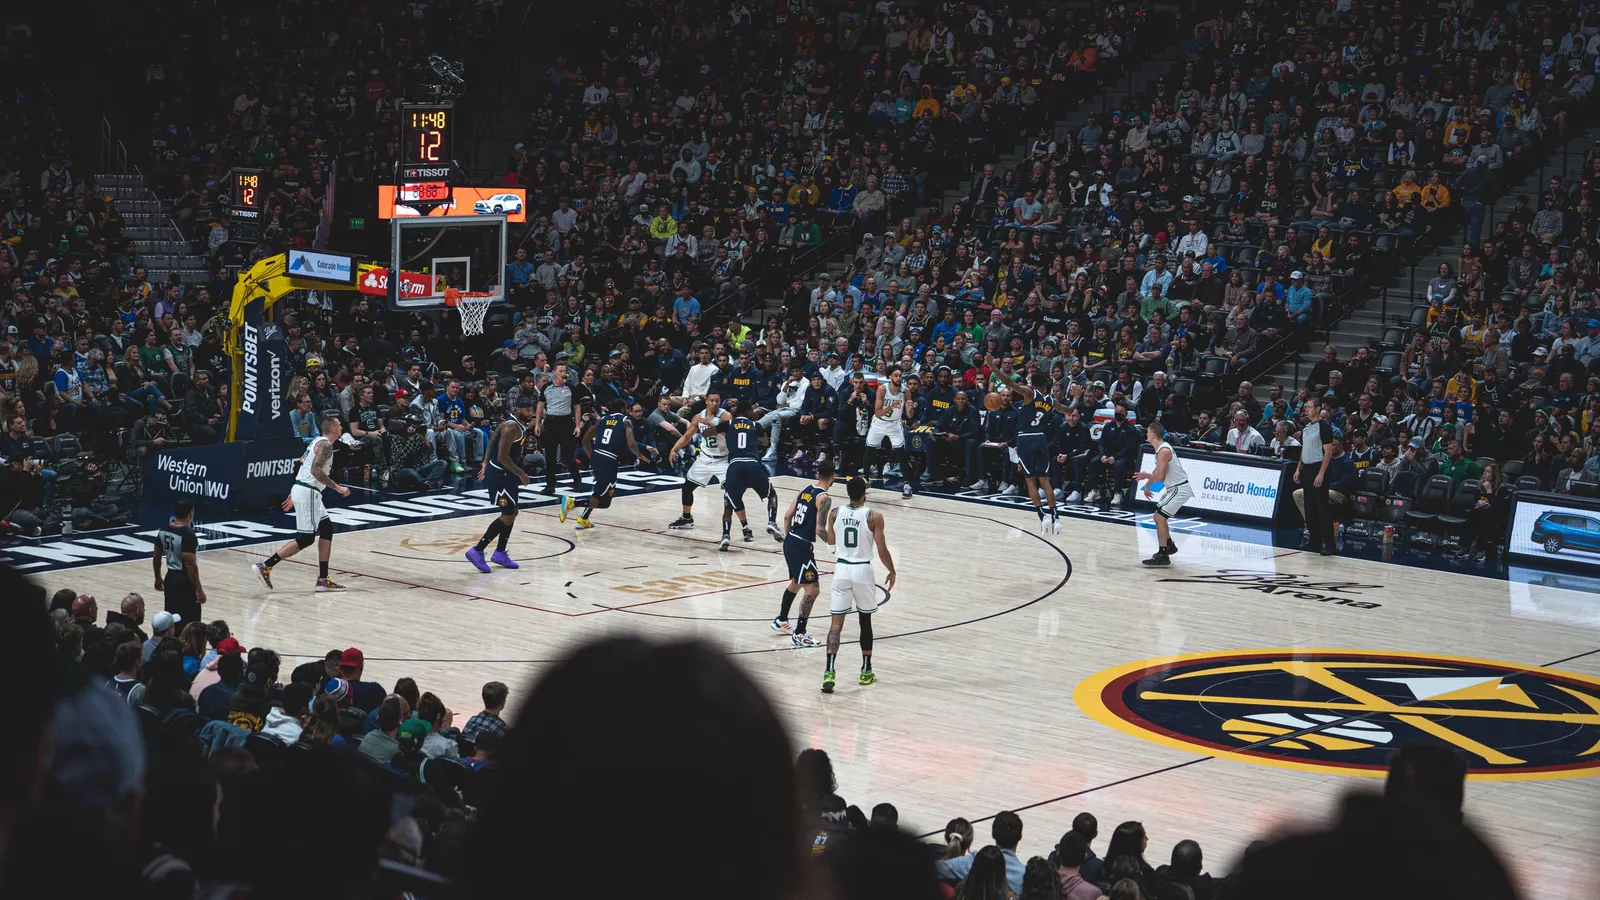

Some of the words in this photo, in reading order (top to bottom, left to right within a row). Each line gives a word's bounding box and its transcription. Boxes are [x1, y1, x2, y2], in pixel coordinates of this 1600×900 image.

[412, 111, 446, 129] 11:48
[420, 131, 441, 161] 12
[239, 174, 258, 188] 11:48
[418, 167, 449, 178] TISSOT
[1346, 169, 1356, 177] 27
[243, 188, 254, 205] 12
[317, 260, 336, 270] Colorado
[242, 321, 258, 415] POINTSBET
[268, 356, 281, 420] verizon
[733, 377, 751, 386] DENVER
[932, 399, 950, 409] DENVER
[733, 422, 751, 431] GREEN
[1030, 411, 1044, 427] 3
[601, 428, 613, 445] 9
[737, 431, 747, 450] 0
[157, 454, 207, 478] Western
[168, 474, 204, 494] Union
[208, 483, 230, 500] WU
[1203, 476, 1245, 494] Colorado
[1246, 481, 1277, 499] Honda
[1201, 492, 1233, 503] DEALERS
[794, 502, 808, 525] 25
[841, 518, 861, 528] TATUM
[844, 527, 858, 548] 0
[1155, 568, 1385, 595] Ball
[1238, 584, 1382, 609] Arena
[813, 835, 828, 846] 27
